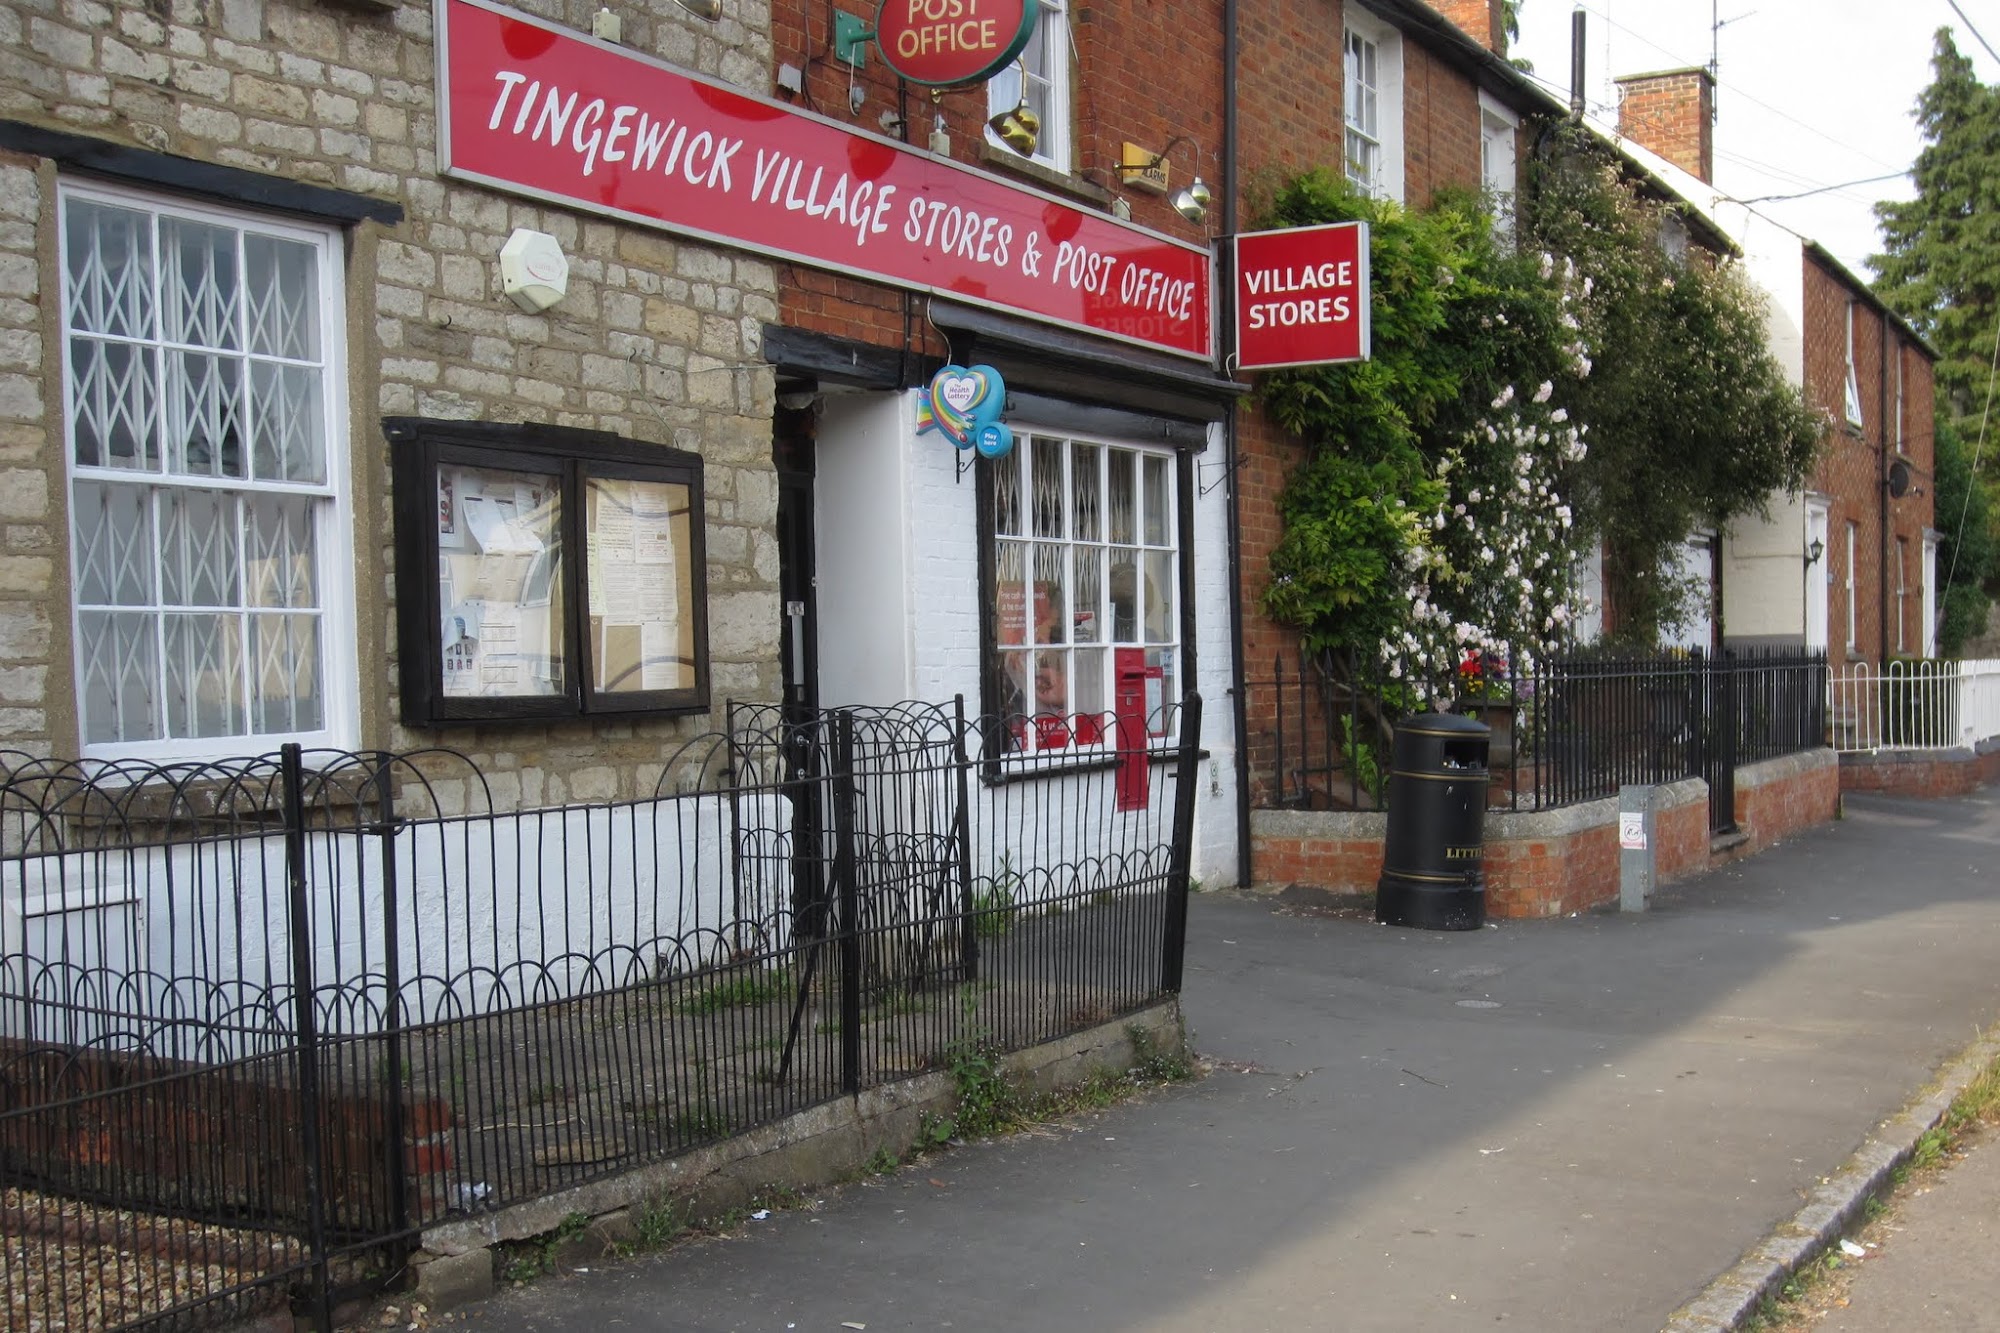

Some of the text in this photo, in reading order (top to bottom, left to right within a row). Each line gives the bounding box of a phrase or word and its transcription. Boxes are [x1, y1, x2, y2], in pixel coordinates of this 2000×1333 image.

[897, 19, 997, 58] OFFICE
[488, 70, 744, 193] TINGEWICK
[751, 148, 897, 247] VILLAGE
[903, 196, 1013, 267] STORES
[1021, 230, 1043, 278] &
[1052, 240, 1117, 296] POST
[1121, 262, 1196, 321] OFFICE
[1244, 261, 1353, 295] VILLAGE
[1248, 296, 1351, 329] STORES
[984, 433, 997, 441] Play
